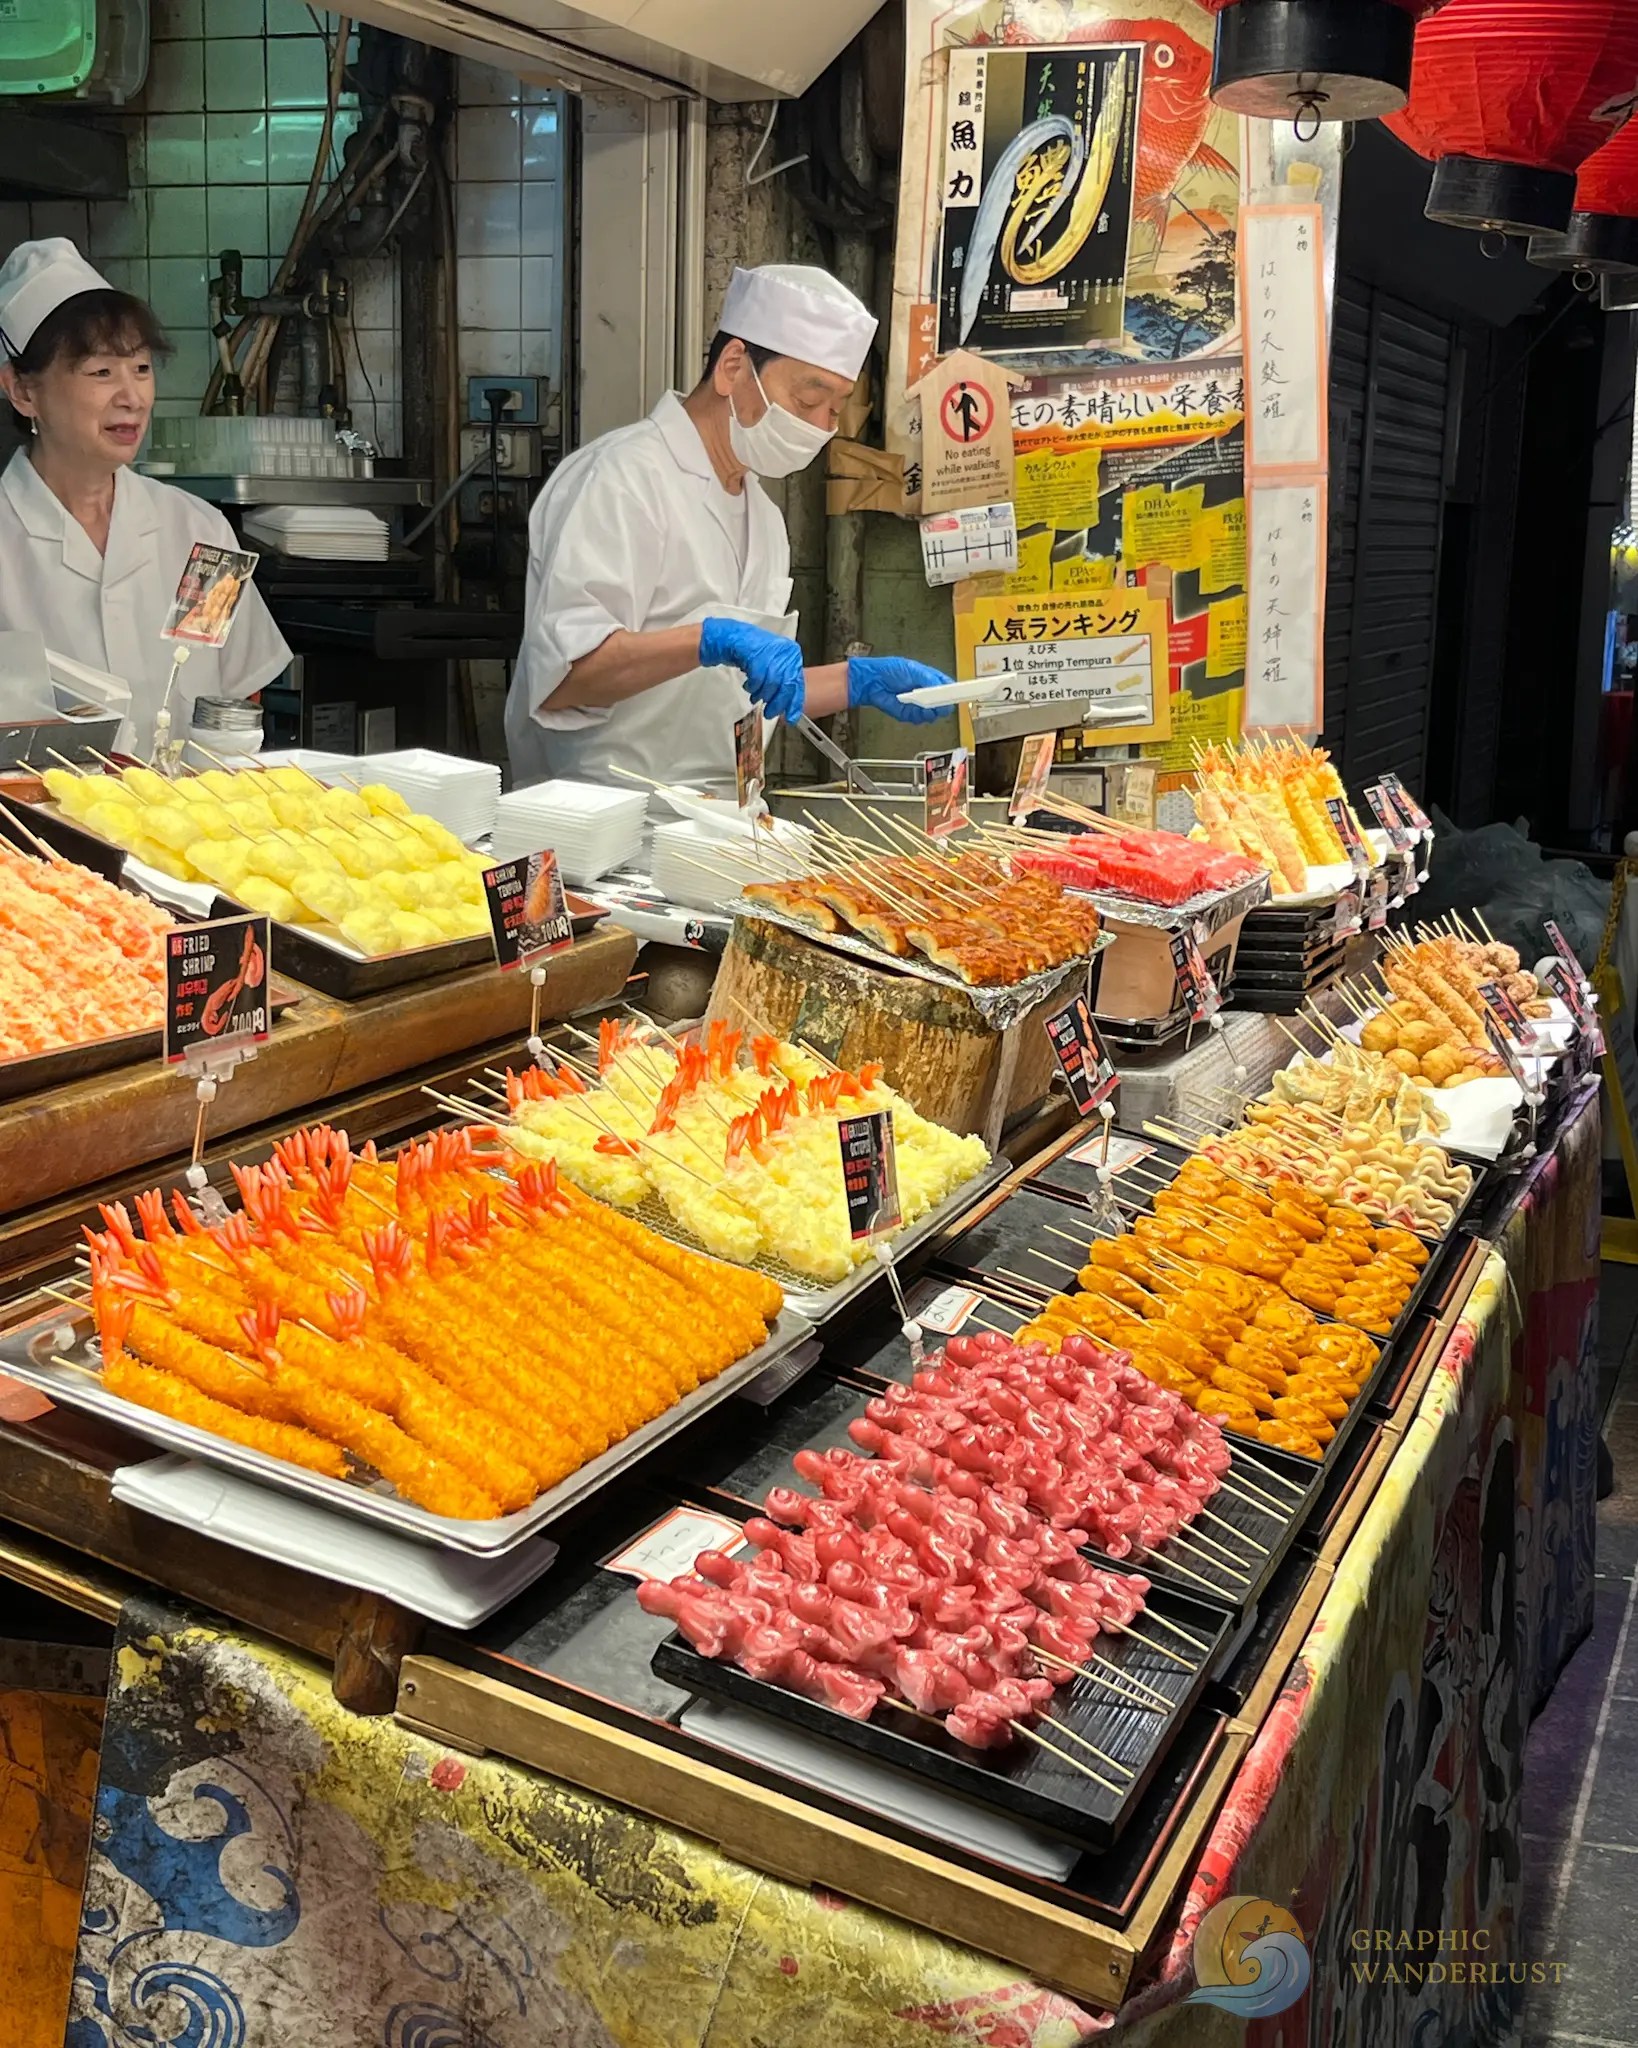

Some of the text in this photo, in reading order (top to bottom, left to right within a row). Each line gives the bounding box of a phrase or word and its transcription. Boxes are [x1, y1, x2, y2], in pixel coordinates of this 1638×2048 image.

[948, 120, 977, 198] 魚力
[945, 446, 991, 460] No eating
[936, 459, 1001, 476] while walking
[981, 608, 1141, 643] 人気ランキング
[1027, 643, 1058, 655] えび天
[1027, 658, 1064, 672] Shrimp
[1066, 656, 1112, 670] Tempura
[1028, 674, 1059, 686] はも天
[1028, 689, 1047, 700] Sea
[1049, 689, 1064, 699] Eel
[1066, 686, 1111, 699] Tempura
[541, 916, 569, 941] 700円
[183, 934, 210, 956] FRIED
[182, 954, 216, 977] SHRIMP
